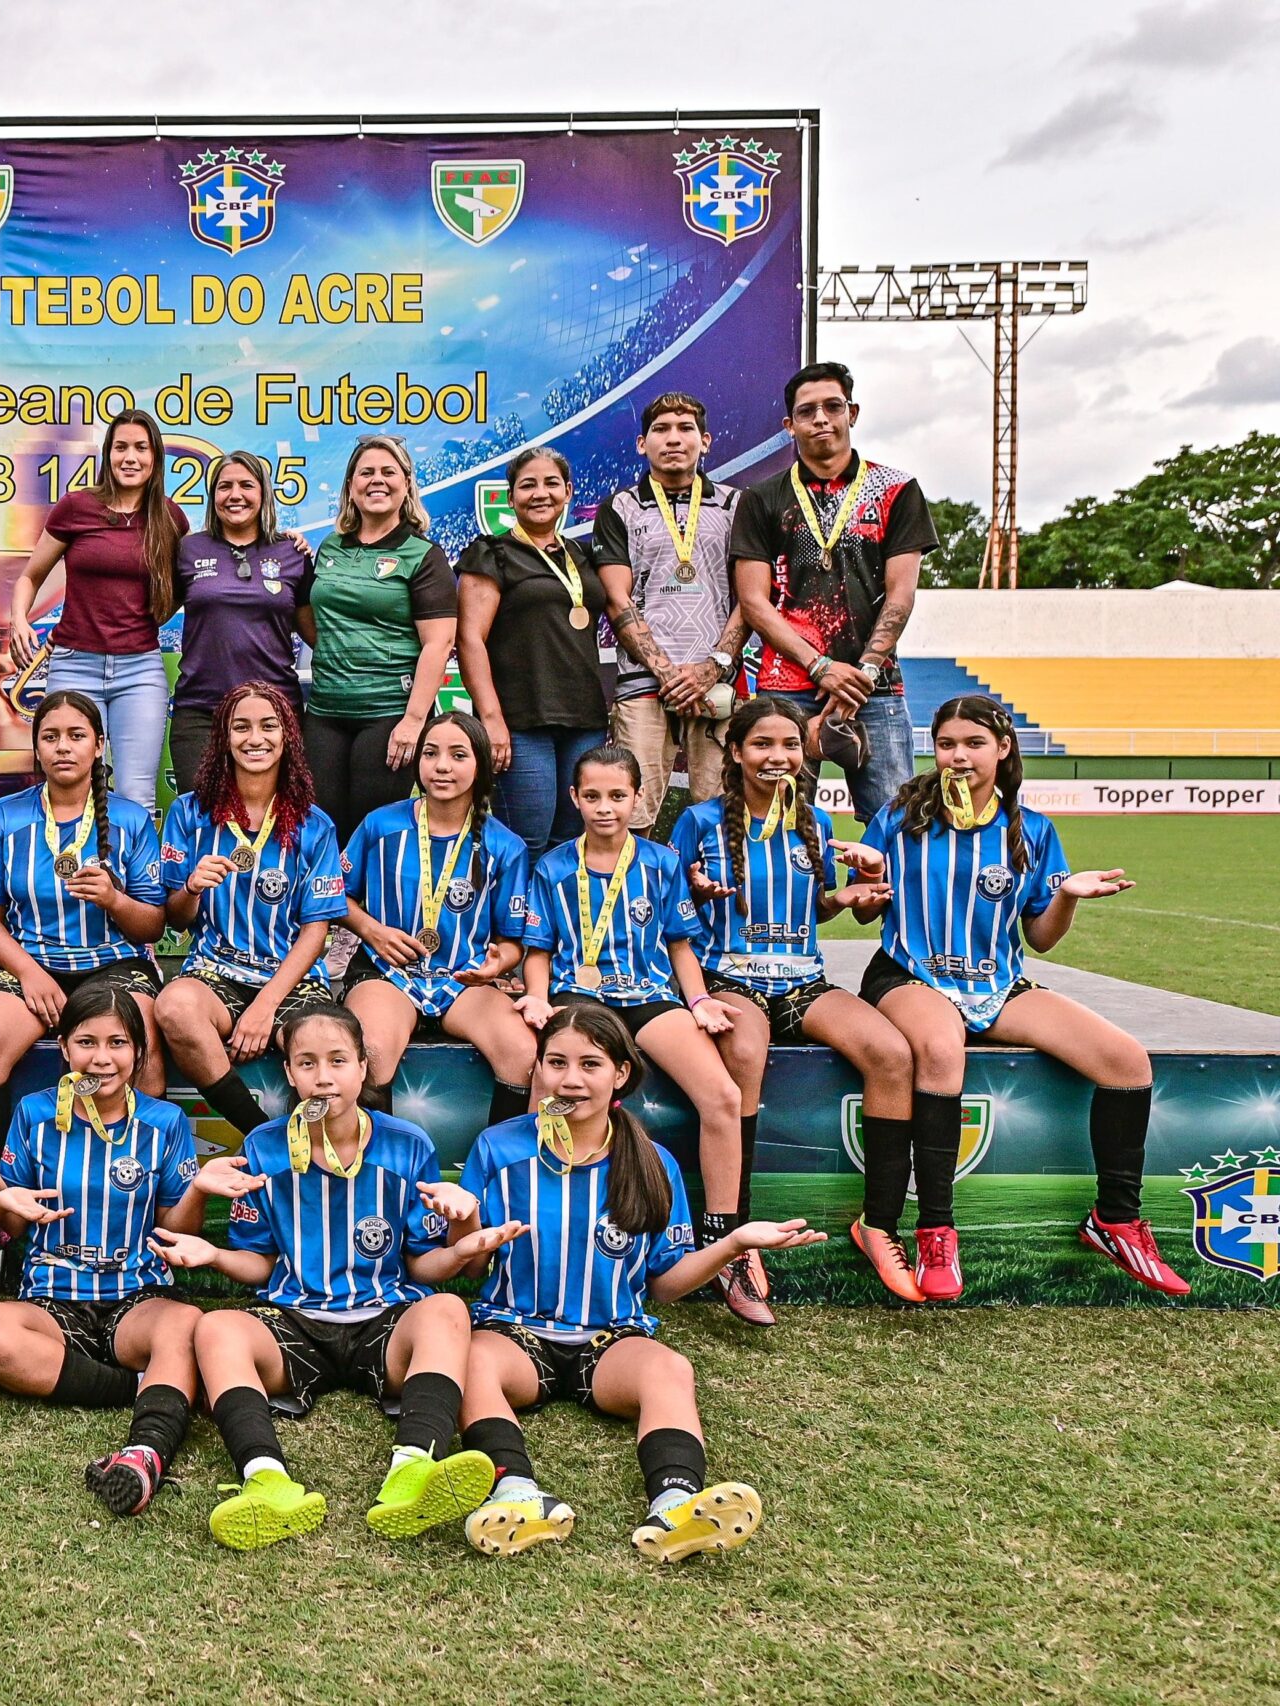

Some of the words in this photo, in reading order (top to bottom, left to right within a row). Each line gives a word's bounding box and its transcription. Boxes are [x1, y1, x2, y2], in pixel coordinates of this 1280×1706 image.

[445, 171, 510, 184] FFAC
[710, 190, 748, 200] CBF
[215, 201, 253, 211] CBF
[191, 274, 266, 326] DO
[280, 273, 424, 324] ACRE
[155, 373, 233, 426] de
[256, 371, 487, 426] Futebol
[194, 558, 218, 569] CBF
[1093, 786, 1174, 808] Topper
[1184, 786, 1265, 808] Topper
[1237, 1214, 1280, 1224] CB
